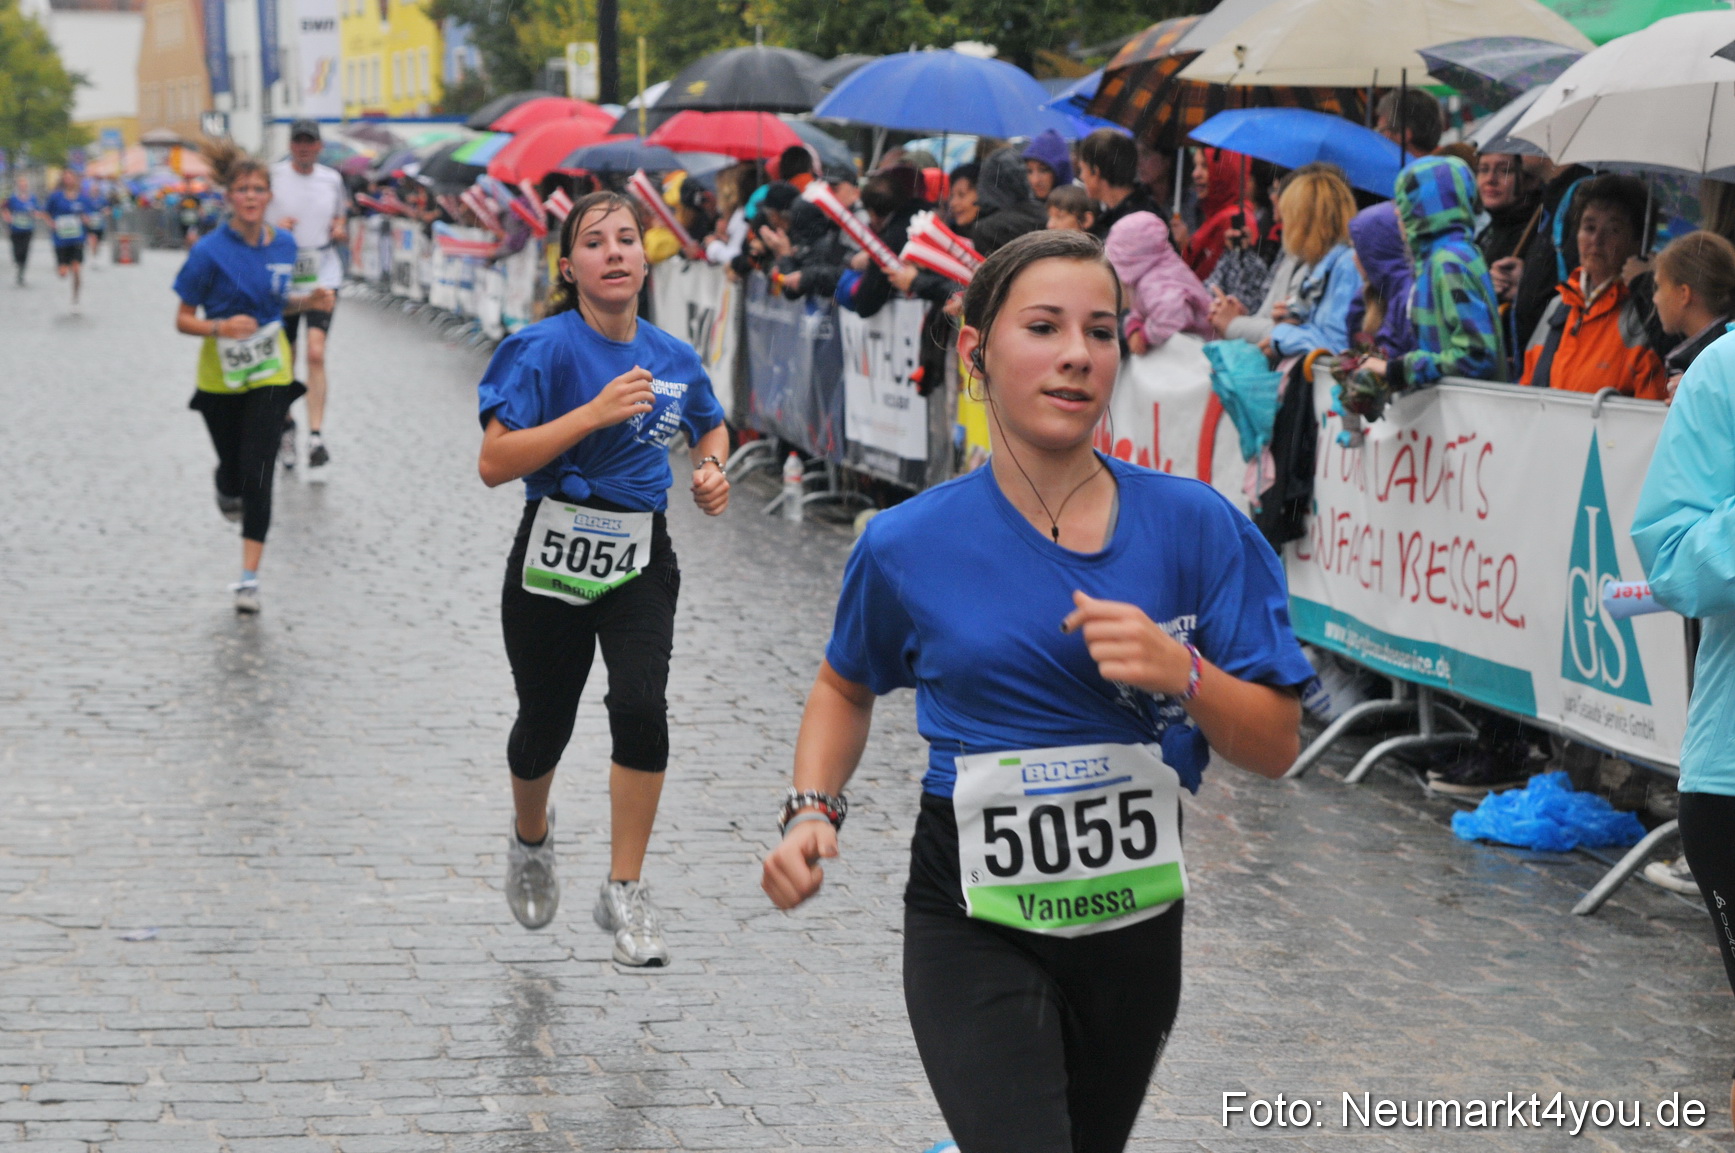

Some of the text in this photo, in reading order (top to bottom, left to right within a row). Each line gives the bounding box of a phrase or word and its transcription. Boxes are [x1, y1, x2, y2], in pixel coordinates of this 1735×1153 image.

[1374, 429, 1493, 520] LÄUFTS
[574, 513, 622, 530] BOCK
[540, 529, 638, 579] 5054
[1629, 713, 1656, 741] GmbH
[1022, 756, 1109, 783] BOCK
[983, 789, 1157, 878] 5055
[1017, 887, 1136, 921] Vanessa
